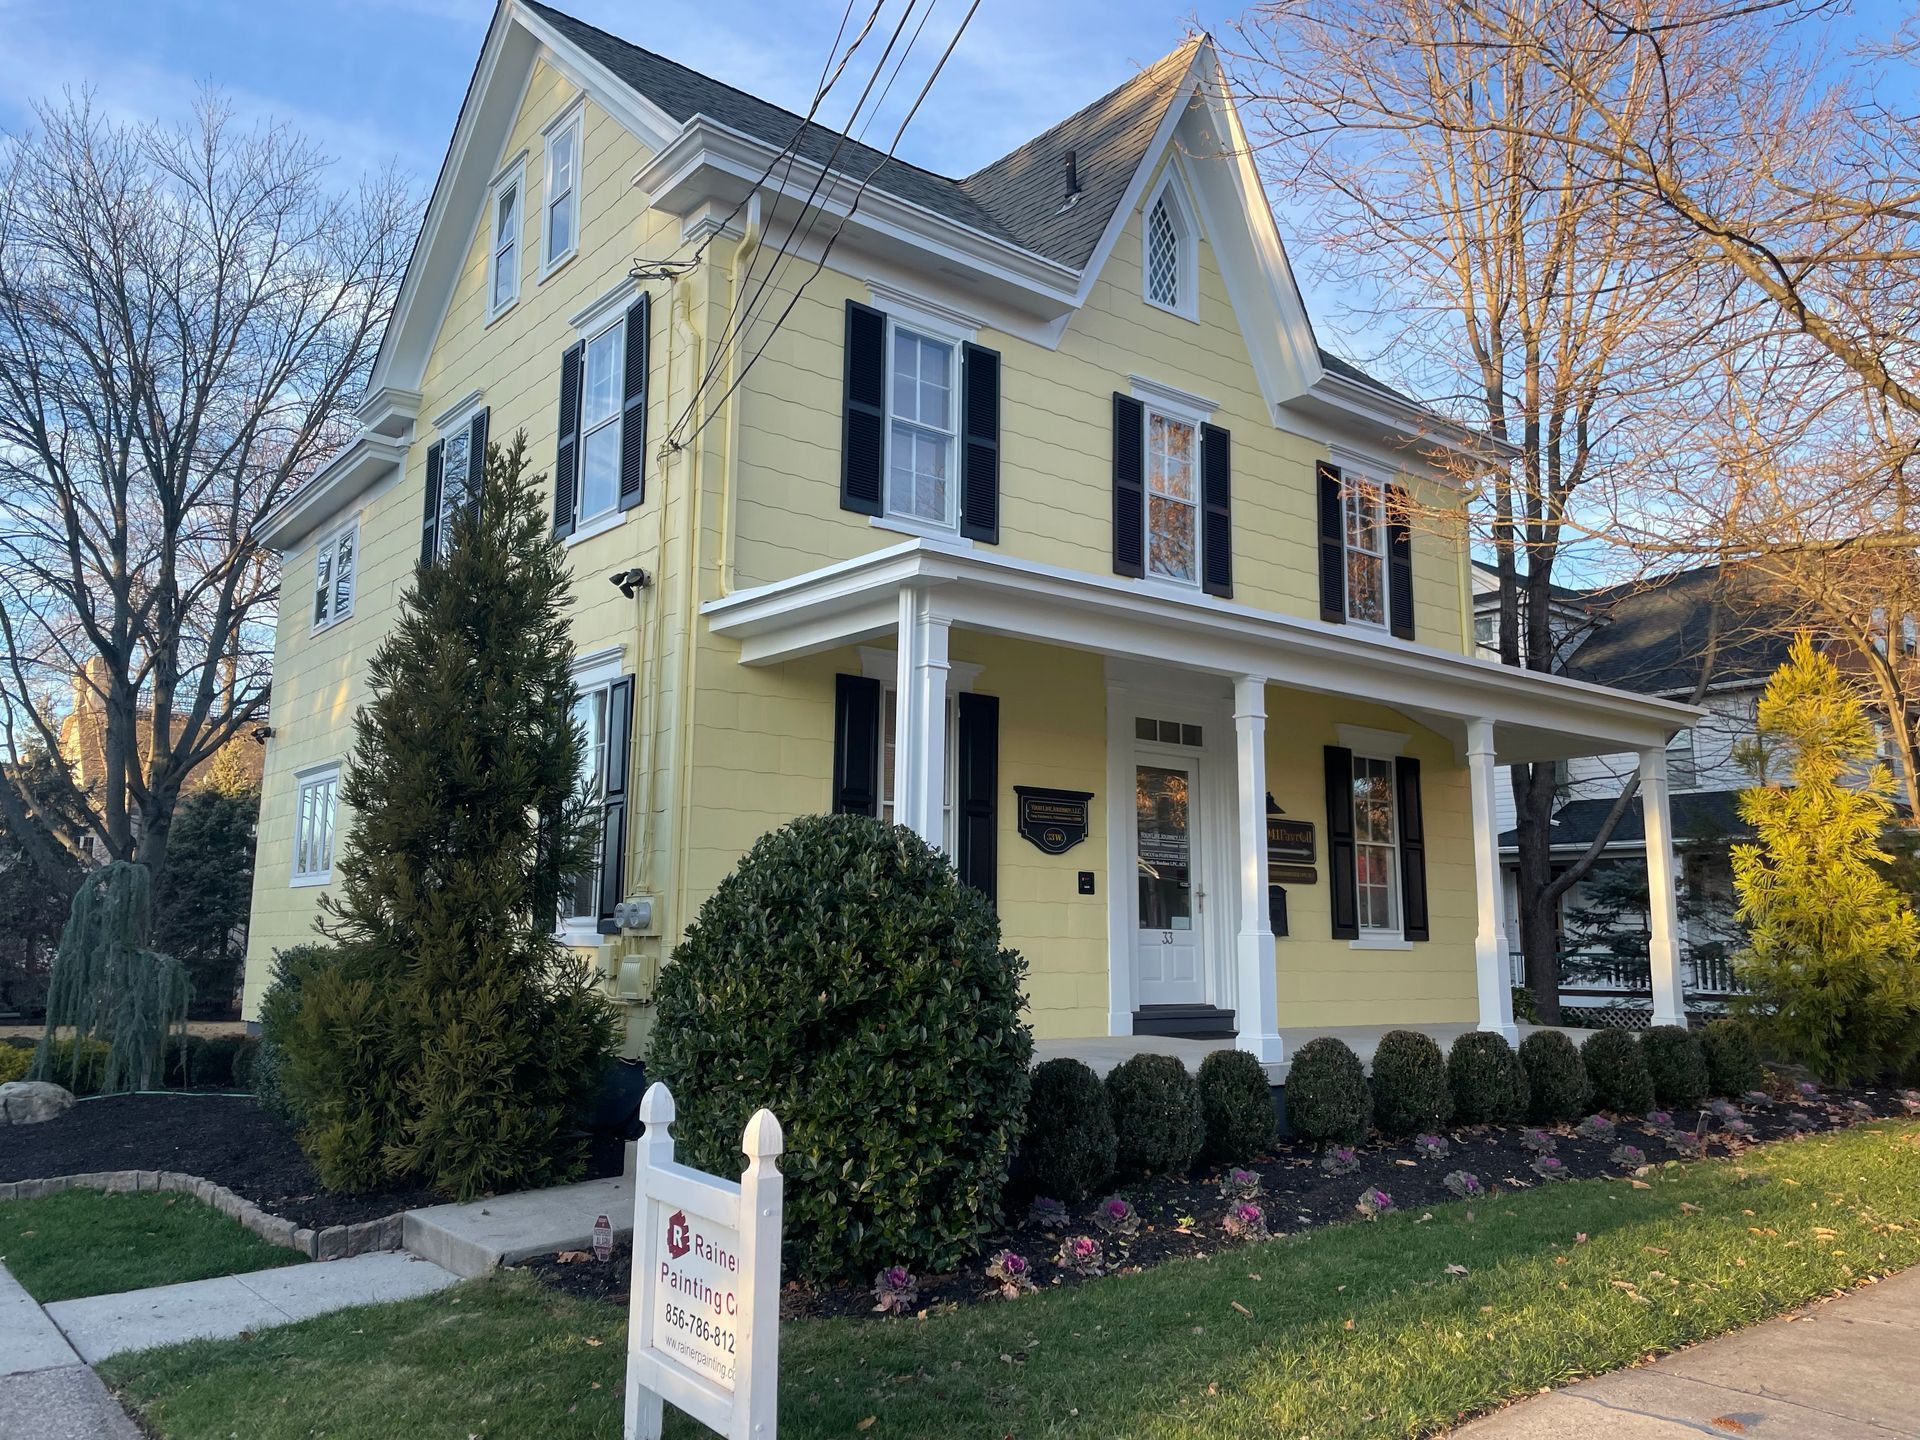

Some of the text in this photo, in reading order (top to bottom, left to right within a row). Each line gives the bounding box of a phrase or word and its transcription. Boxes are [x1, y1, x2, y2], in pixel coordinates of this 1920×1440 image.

[1161, 931, 1173, 945] 33
[672, 1224, 683, 1249] R
[660, 1261, 738, 1317] Painting C
[665, 1302, 736, 1354] 856-786-812
